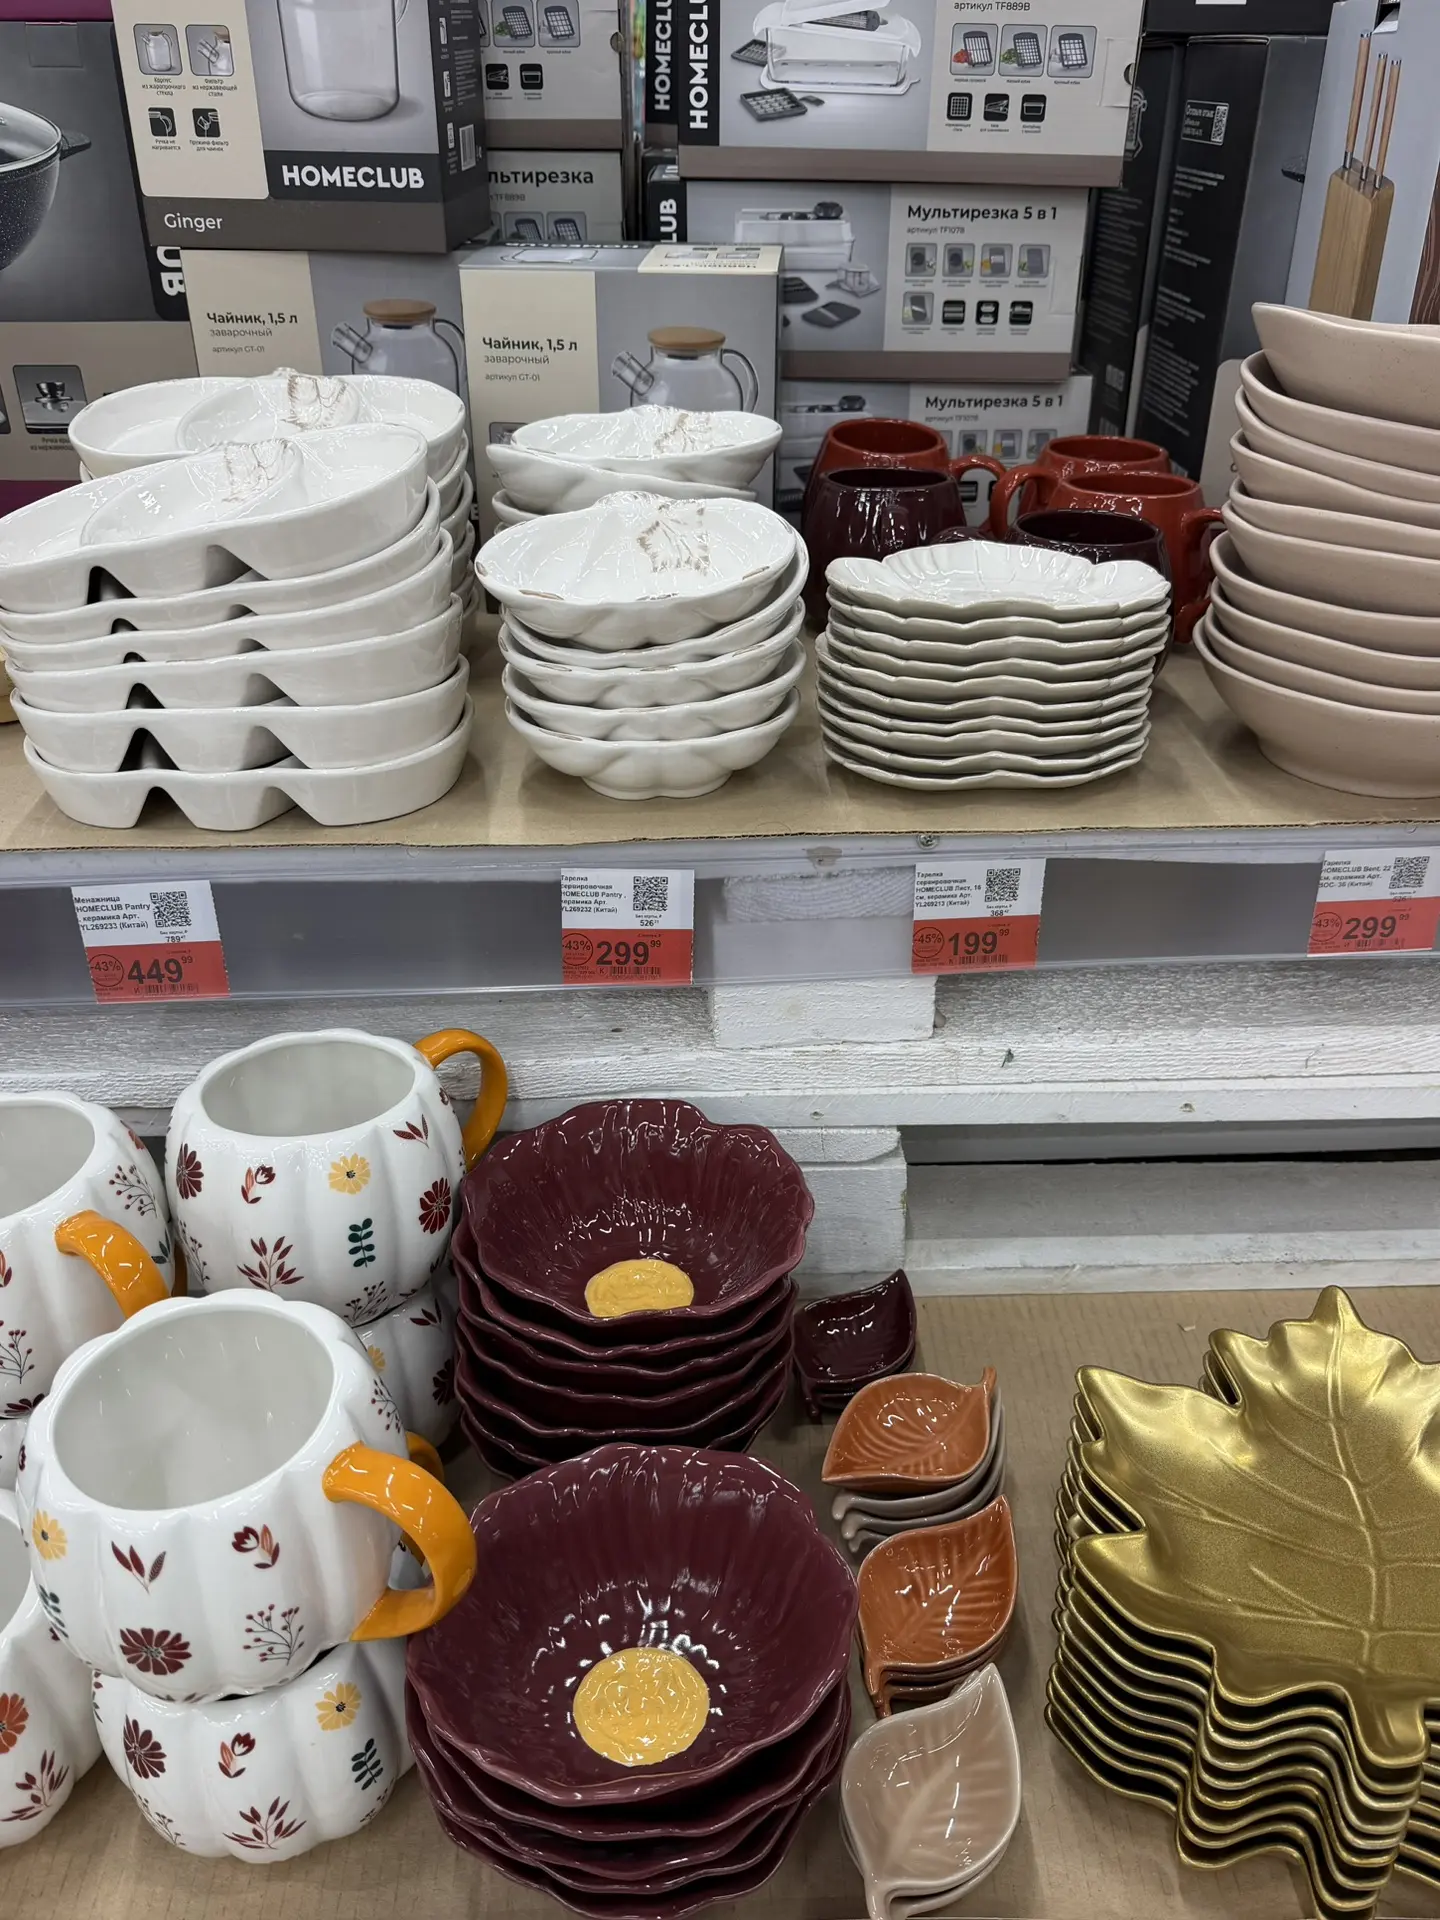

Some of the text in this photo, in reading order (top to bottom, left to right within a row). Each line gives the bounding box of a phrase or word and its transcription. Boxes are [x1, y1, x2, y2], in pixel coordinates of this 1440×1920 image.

[954, 2, 993, 12] артикул
[689, 0, 708, 129] HOMECL
[282, 165, 425, 189] HOMECLUB
[907, 205, 1057, 223] Мультирезка 5 в 1
[164, 213, 223, 232] Ginger
[206, 312, 298, 326] Чайник, 1,5 л
[209, 328, 273, 338] заварочный
[212, 346, 243, 354] артикул
[482, 336, 578, 353] Чайник, 1,5 л
[484, 354, 550, 365] заварочный
[485, 374, 517, 382] артикул
[925, 394, 1063, 411] Мультирезка 5 в 1
[74, 896, 121, 904] Менажница
[76, 903, 151, 913] HOMECLUB Pantry
[594, 906, 618, 914] (Китай)
[83, 914, 121, 922] керамика
[122, 913, 140, 921] Арт.
[80, 921, 149, 931] YL269233 (Китай)
[1342, 916, 1397, 940] 299
[948, 928, 1010, 956] 199 99
[596, 941, 650, 966] 299
[650, 940, 662, 948] 99
[90, 960, 122, 972] -43%
[128, 955, 194, 985] 449 99
